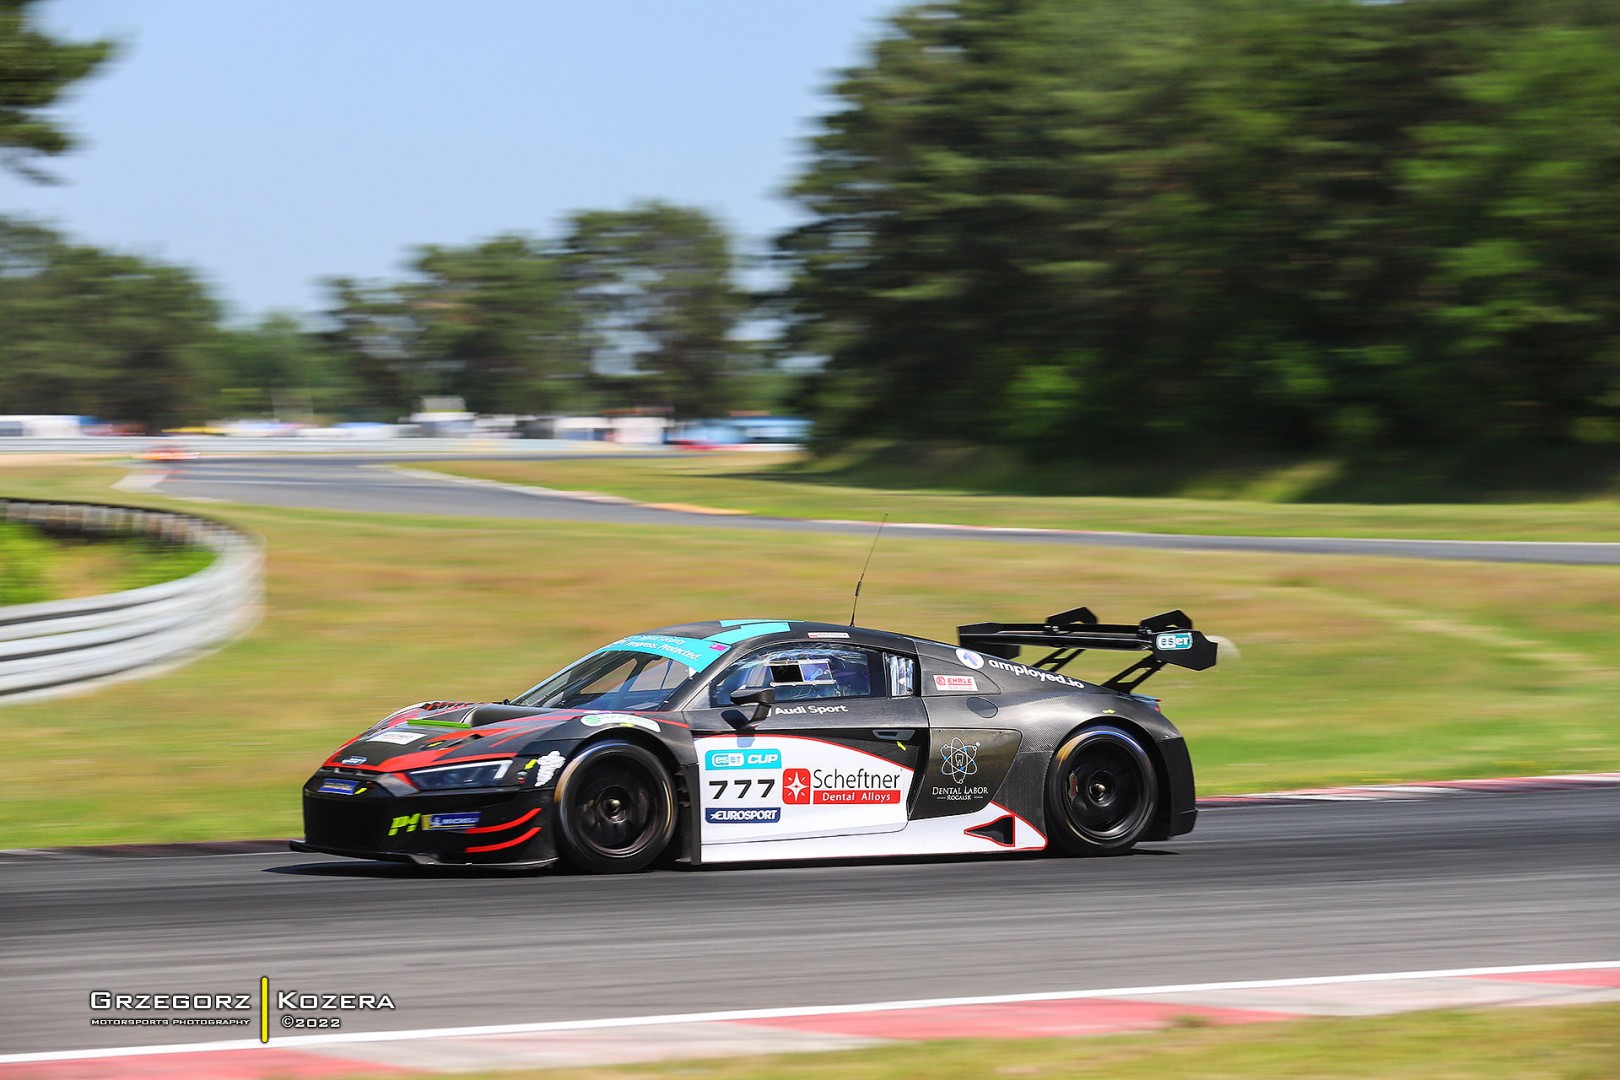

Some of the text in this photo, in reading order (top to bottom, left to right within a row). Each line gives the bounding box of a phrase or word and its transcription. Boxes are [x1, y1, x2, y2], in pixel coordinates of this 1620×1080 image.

[988, 659, 1085, 689] amployed.io
[775, 705, 848, 715] Audi Sport
[747, 753, 779, 765] CUP
[813, 768, 900, 789] Scheftner
[708, 779, 775, 800] 777
[822, 792, 891, 803] Dental Alloys
[712, 810, 778, 820] EUROSPORT
